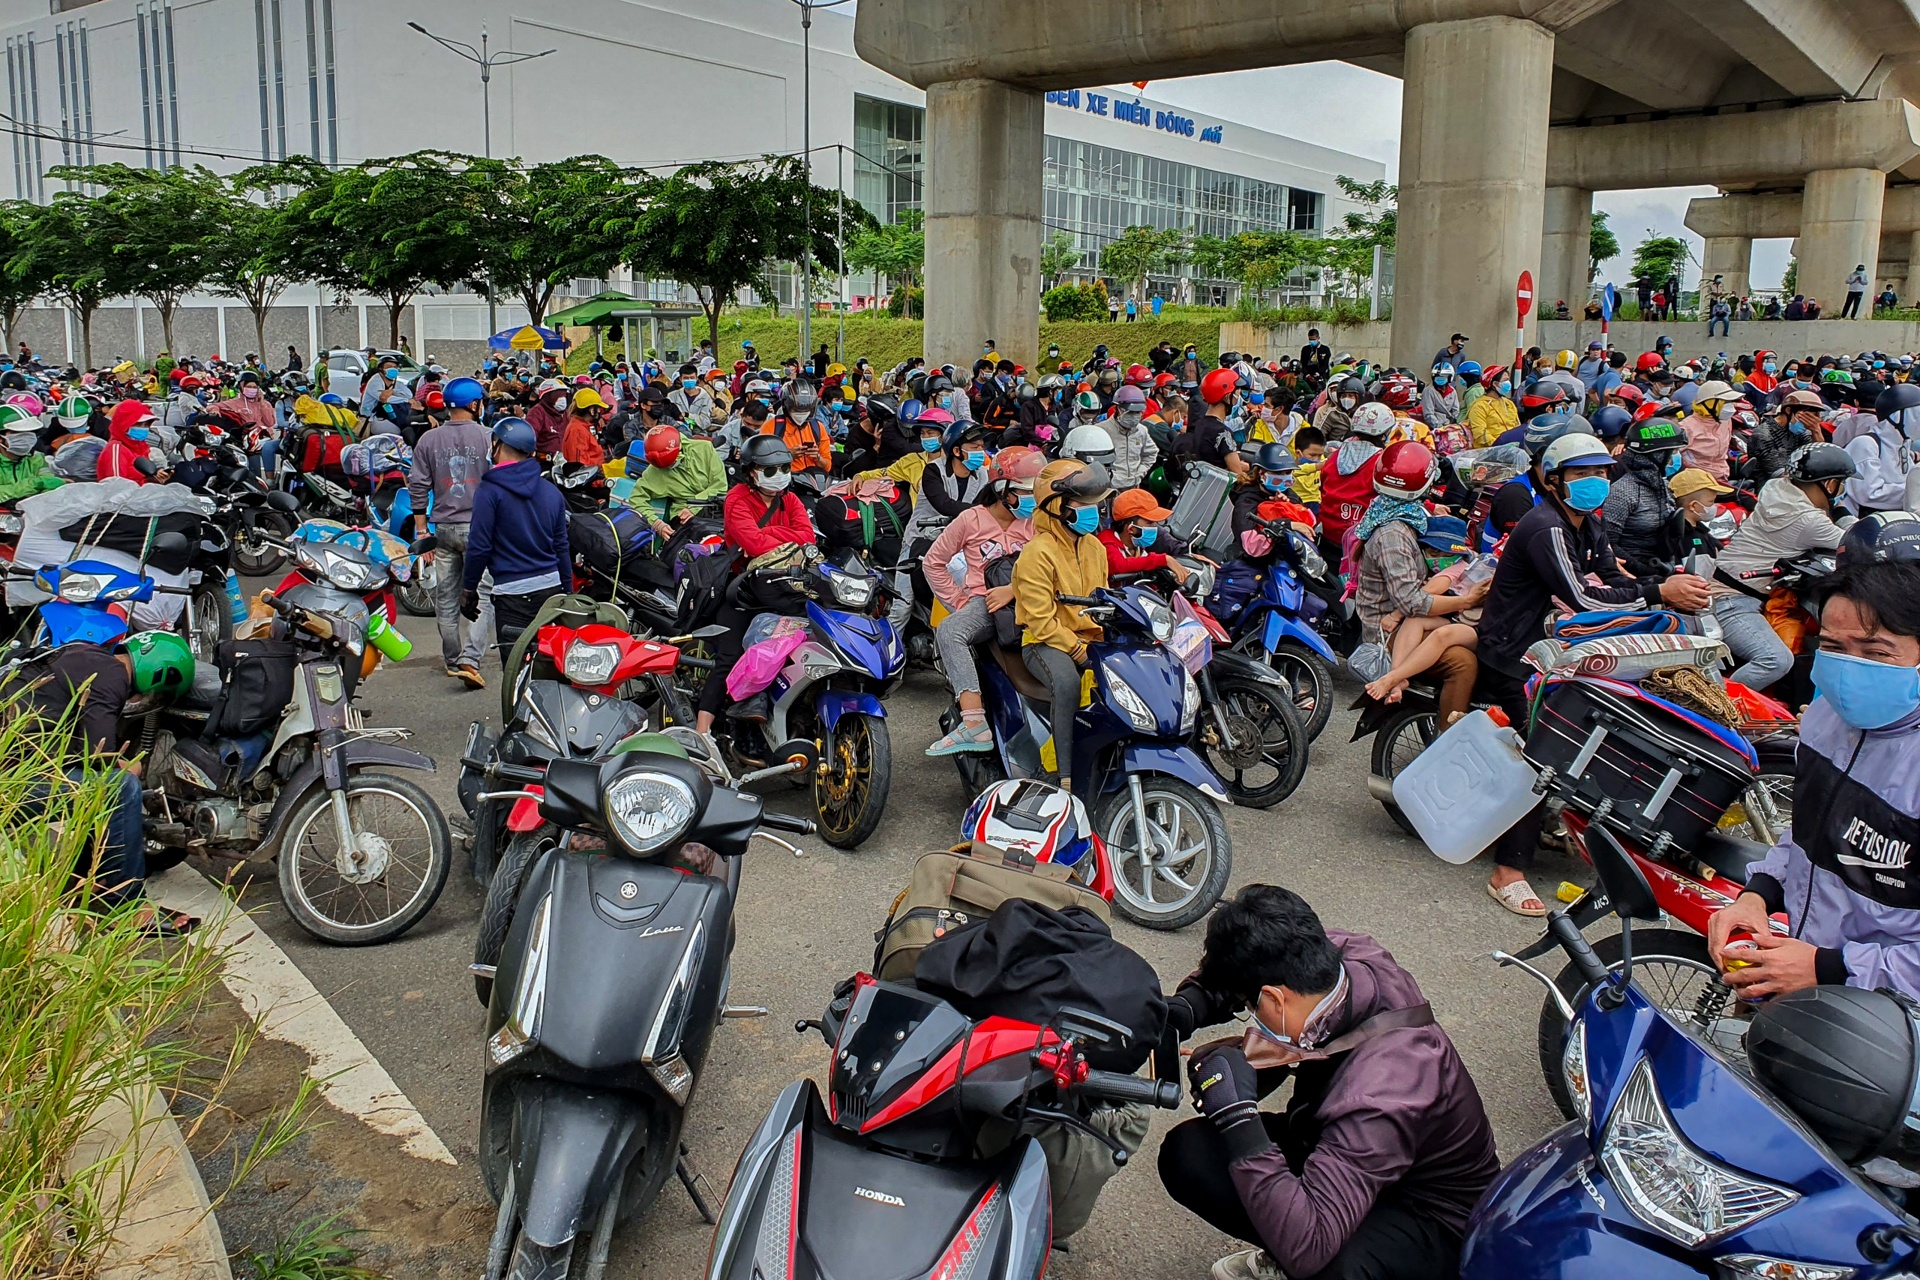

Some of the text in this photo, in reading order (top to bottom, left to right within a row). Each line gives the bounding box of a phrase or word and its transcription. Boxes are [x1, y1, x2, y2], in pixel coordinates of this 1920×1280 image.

[1086, 92, 1108, 116] XE
[1114, 98, 1150, 126] MIỀN
[1156, 110, 1195, 137] ĐÔNG
[1340, 503, 1363, 520] 97
[1671, 874, 1721, 901] WAVE
[1875, 872, 1906, 889] CHAMPION
[854, 1186, 906, 1208] HONDA
